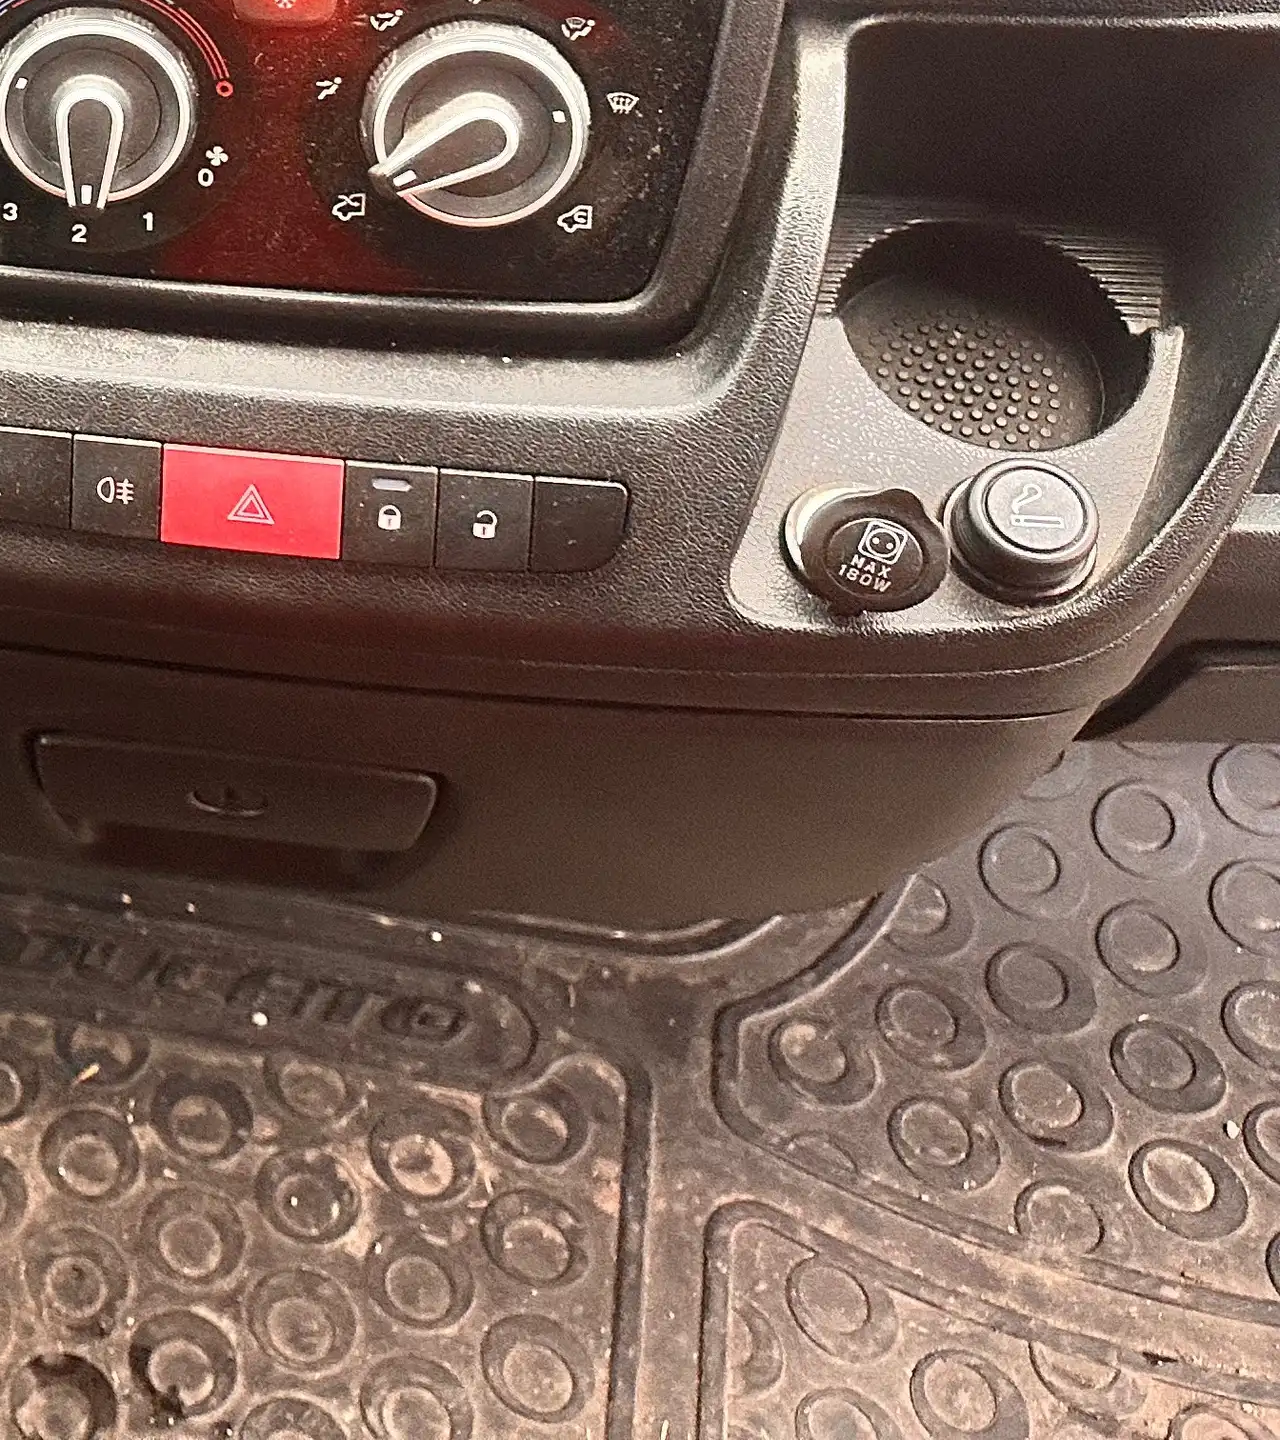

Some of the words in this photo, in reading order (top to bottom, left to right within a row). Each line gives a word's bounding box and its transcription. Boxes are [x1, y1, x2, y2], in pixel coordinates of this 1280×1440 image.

[197, 168, 214, 187] 0
[2, 202, 18, 221] 3
[142, 212, 154, 231] 1
[71, 224, 87, 243] 2
[851, 554, 891, 578] MAX
[839, 564, 892, 592] 180W
